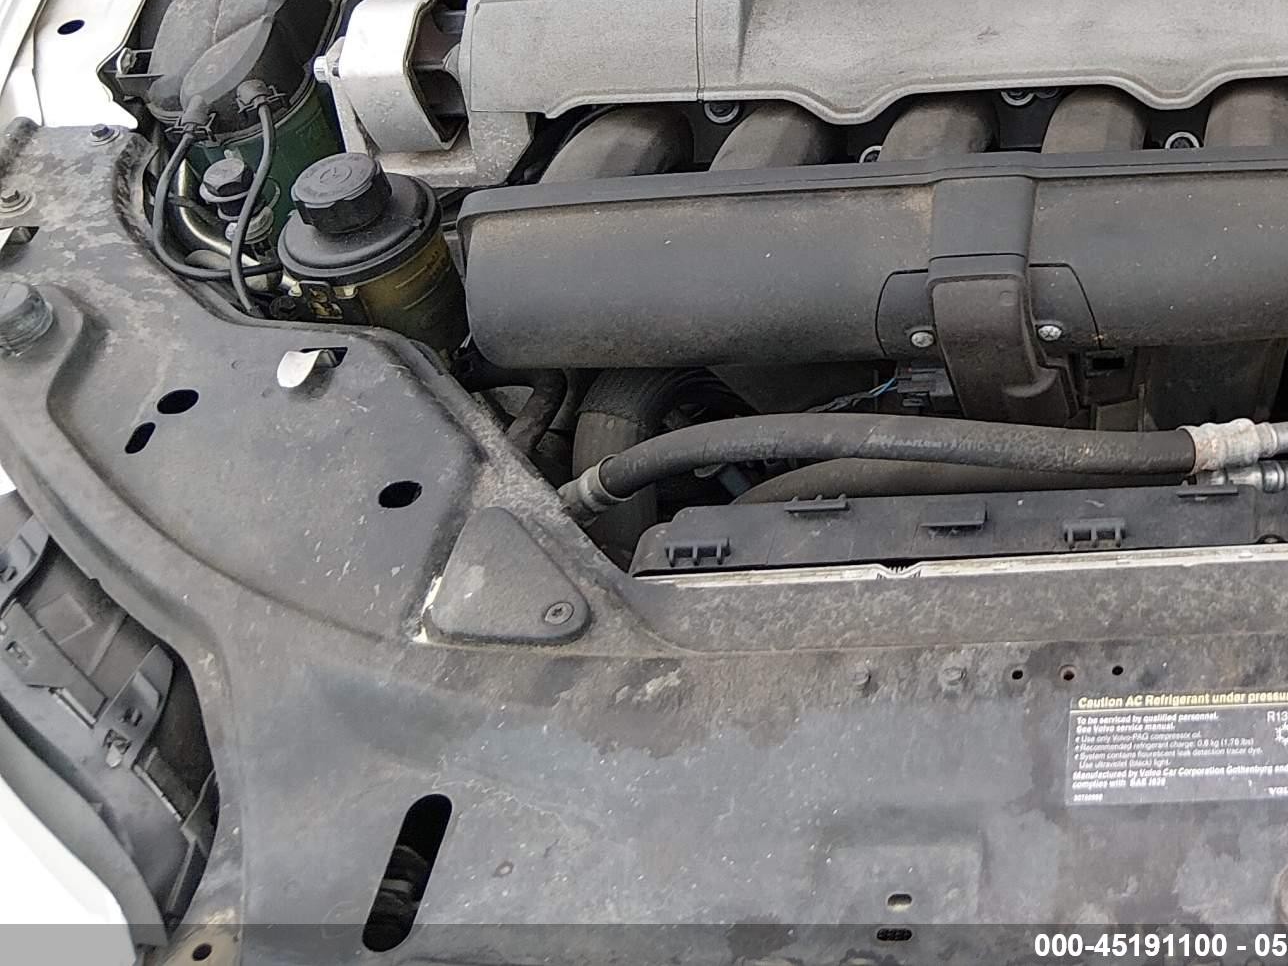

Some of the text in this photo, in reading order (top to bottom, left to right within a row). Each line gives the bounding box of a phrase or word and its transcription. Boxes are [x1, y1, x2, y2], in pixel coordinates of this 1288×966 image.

[1078, 696, 1123, 708] Caution
[1125, 695, 1143, 707] AC
[1145, 694, 1209, 707] Refrigerant
[1212, 692, 1245, 704] under
[1077, 712, 1219, 724] To be serviced by qualified personnel.
[1093, 724, 1115, 733] Volvo
[1116, 724, 1143, 733] service
[1080, 743, 1133, 751] Recommended
[1133, 741, 1169, 751] refrigerant
[1072, 764, 1288, 780] Manufactured by Volvo Car Corporation Gothenburg and
[1072, 780, 1108, 790] complies
[1109, 779, 1126, 788] with
